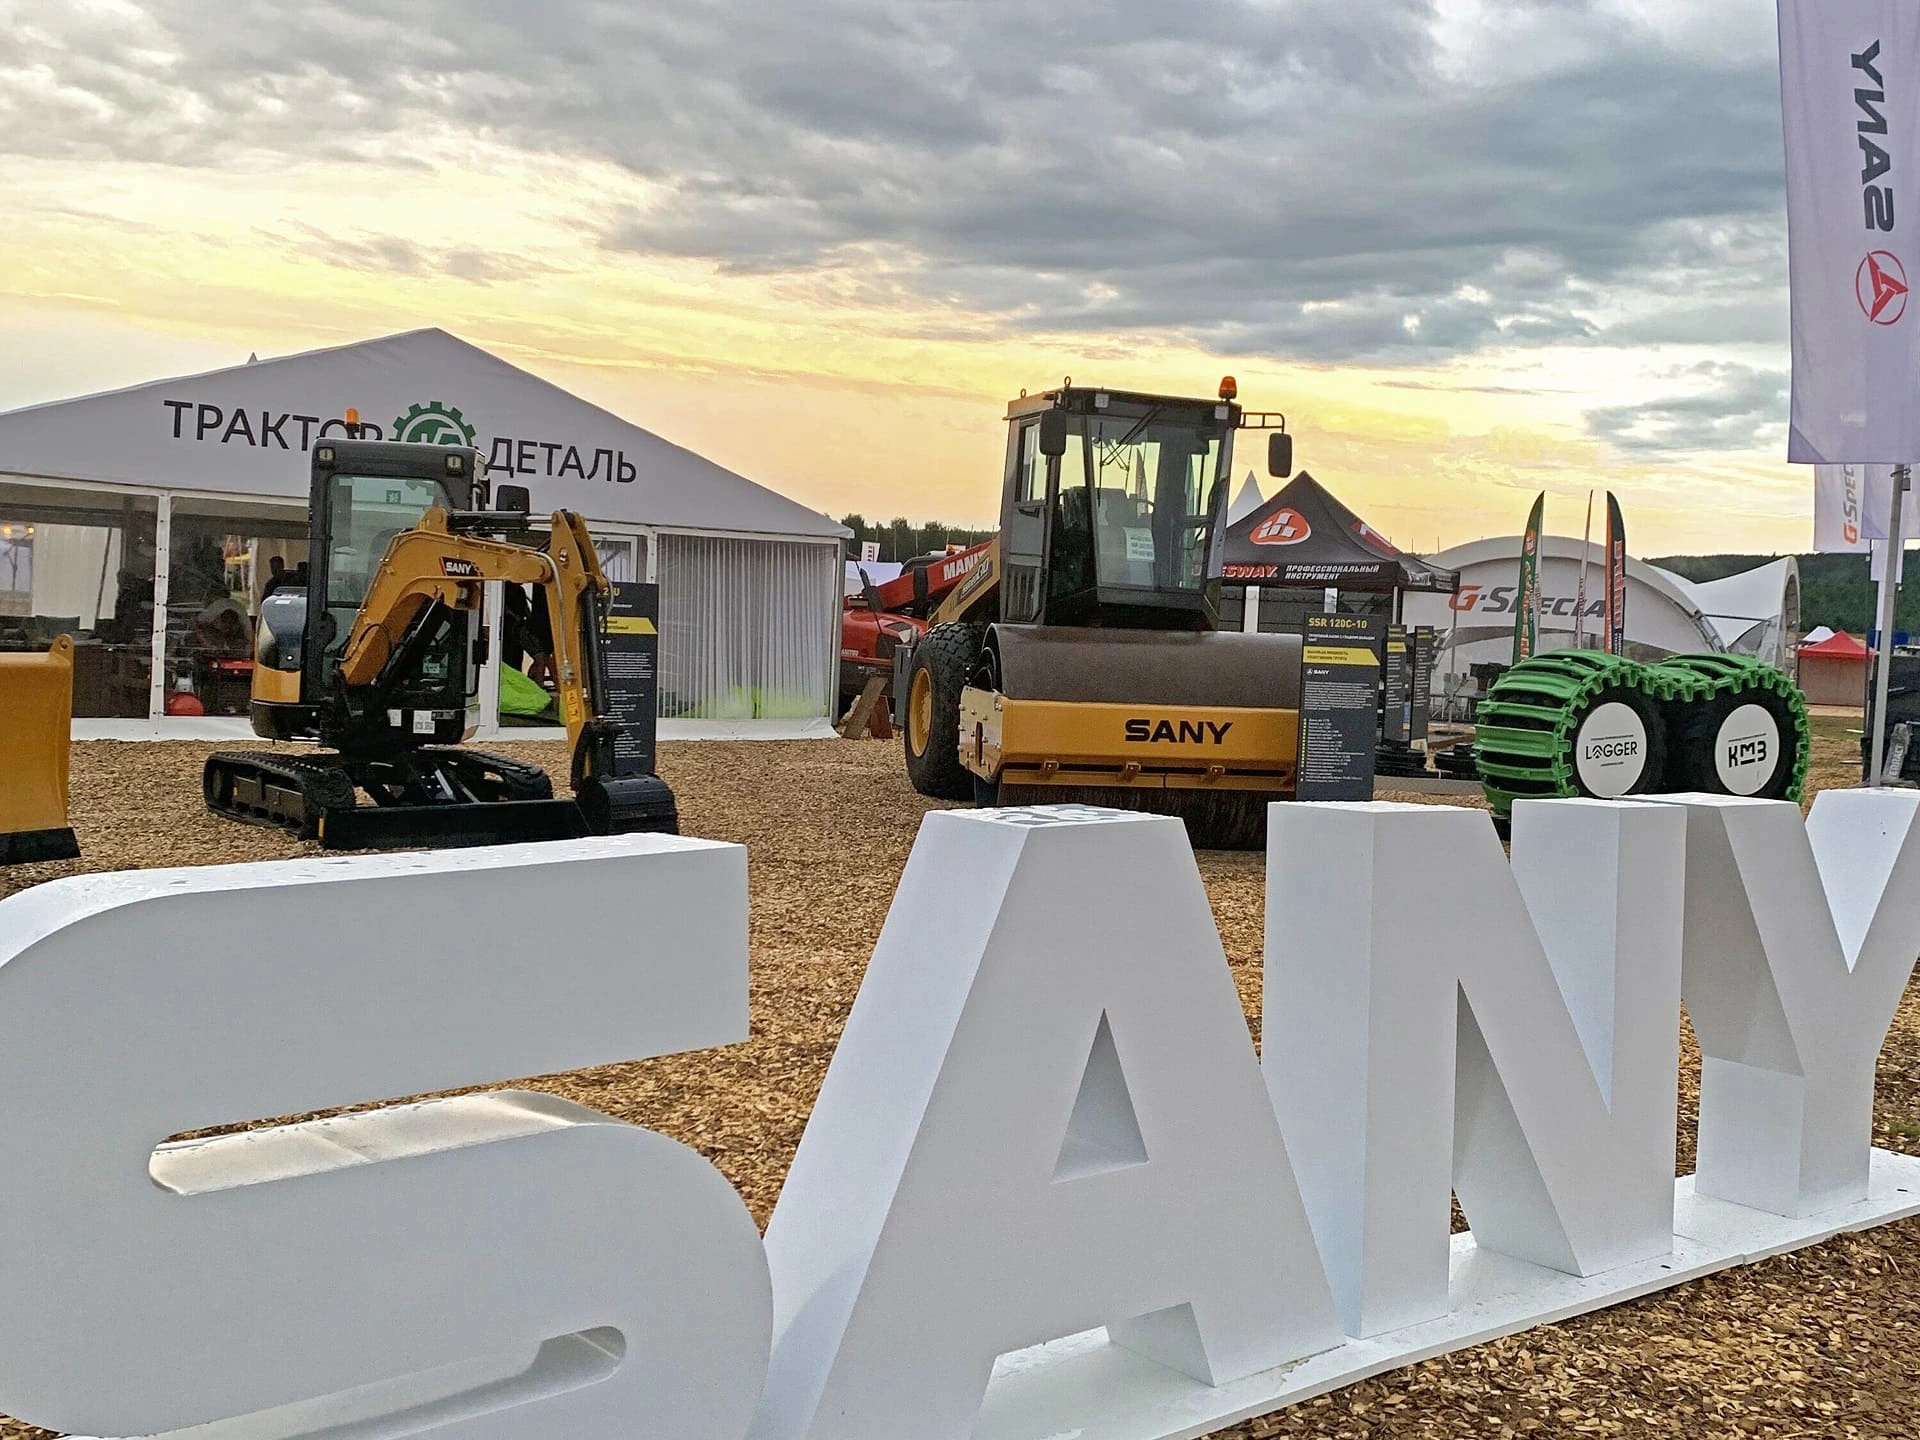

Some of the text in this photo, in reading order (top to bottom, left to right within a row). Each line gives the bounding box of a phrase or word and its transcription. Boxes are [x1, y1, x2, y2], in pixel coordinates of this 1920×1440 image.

[484, 437, 637, 483] ДЕТАЛЬ
[446, 561, 472, 575] SANY
[1284, 572, 1340, 580] ИНСТРУМЕНТ
[1286, 564, 1380, 573] ПРОФЕССИОНАЛЬНЫЙ
[1308, 617, 1368, 629] SSR 120C-10
[1125, 719, 1233, 744] SANY
[1585, 741, 1638, 760] LOGGER
[0, 788, 1920, 1440] SANY
